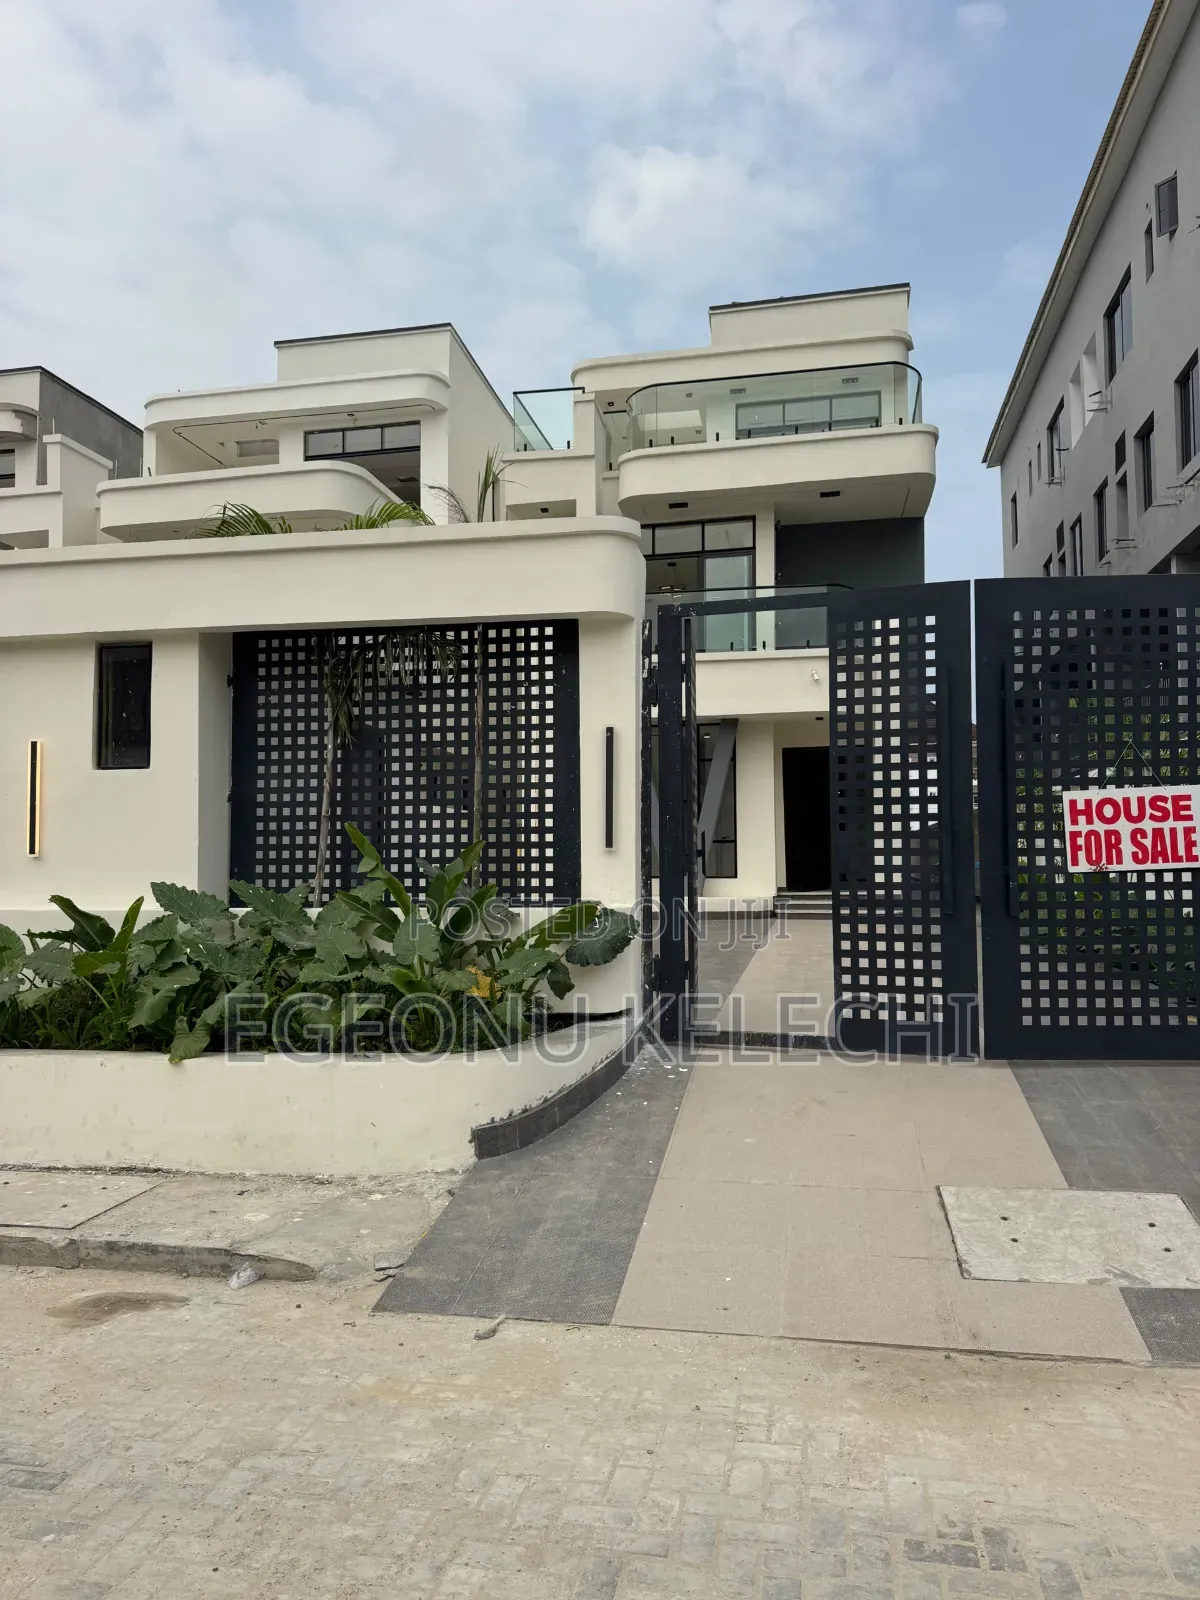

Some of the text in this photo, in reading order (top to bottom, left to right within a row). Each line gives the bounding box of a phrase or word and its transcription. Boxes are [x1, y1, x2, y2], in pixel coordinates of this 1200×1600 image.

[1068, 794, 1194, 826] HOUSE
[1068, 826, 1199, 867] FOR SALE
